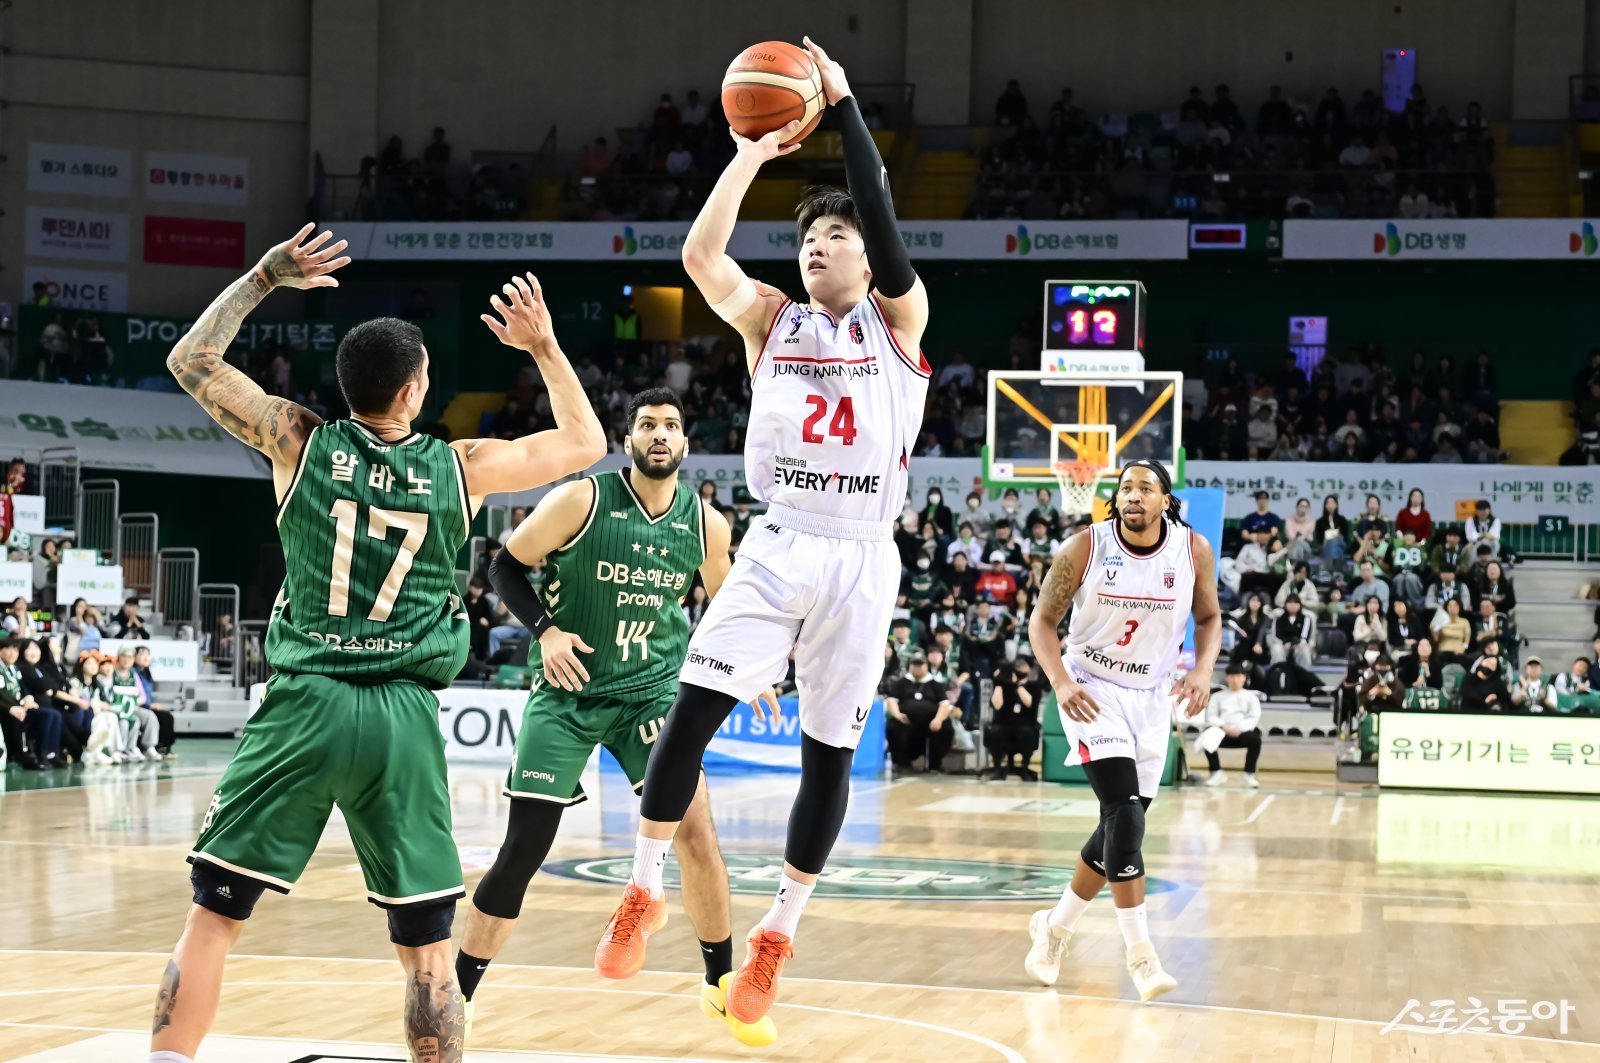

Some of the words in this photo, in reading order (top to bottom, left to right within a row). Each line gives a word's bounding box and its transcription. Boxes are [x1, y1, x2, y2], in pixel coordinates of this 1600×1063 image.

[42, 217, 110, 240] 루덴시아
[386, 232, 428, 249] 나에게
[433, 231, 462, 249] 맞춘
[466, 231, 554, 249] 간편건강보험
[1033, 233, 1119, 250] DB손해보험
[1405, 233, 1467, 249] DB생명
[581, 301, 602, 320] 12
[772, 363, 810, 379] JUNG
[802, 394, 857, 446] 24
[1480, 480, 1544, 503] 나에게
[1553, 480, 1595, 504] 맞춘
[329, 499, 429, 622] 17
[1394, 547, 1422, 566] DB
[597, 561, 687, 590] DB손해보험
[616, 592, 663, 611] promy
[1097, 596, 1121, 608] JUNG
[615, 620, 656, 662] 44
[1116, 619, 1139, 647] 3
[1390, 738, 1531, 764] 유압기기는
[522, 770, 555, 783] promy
